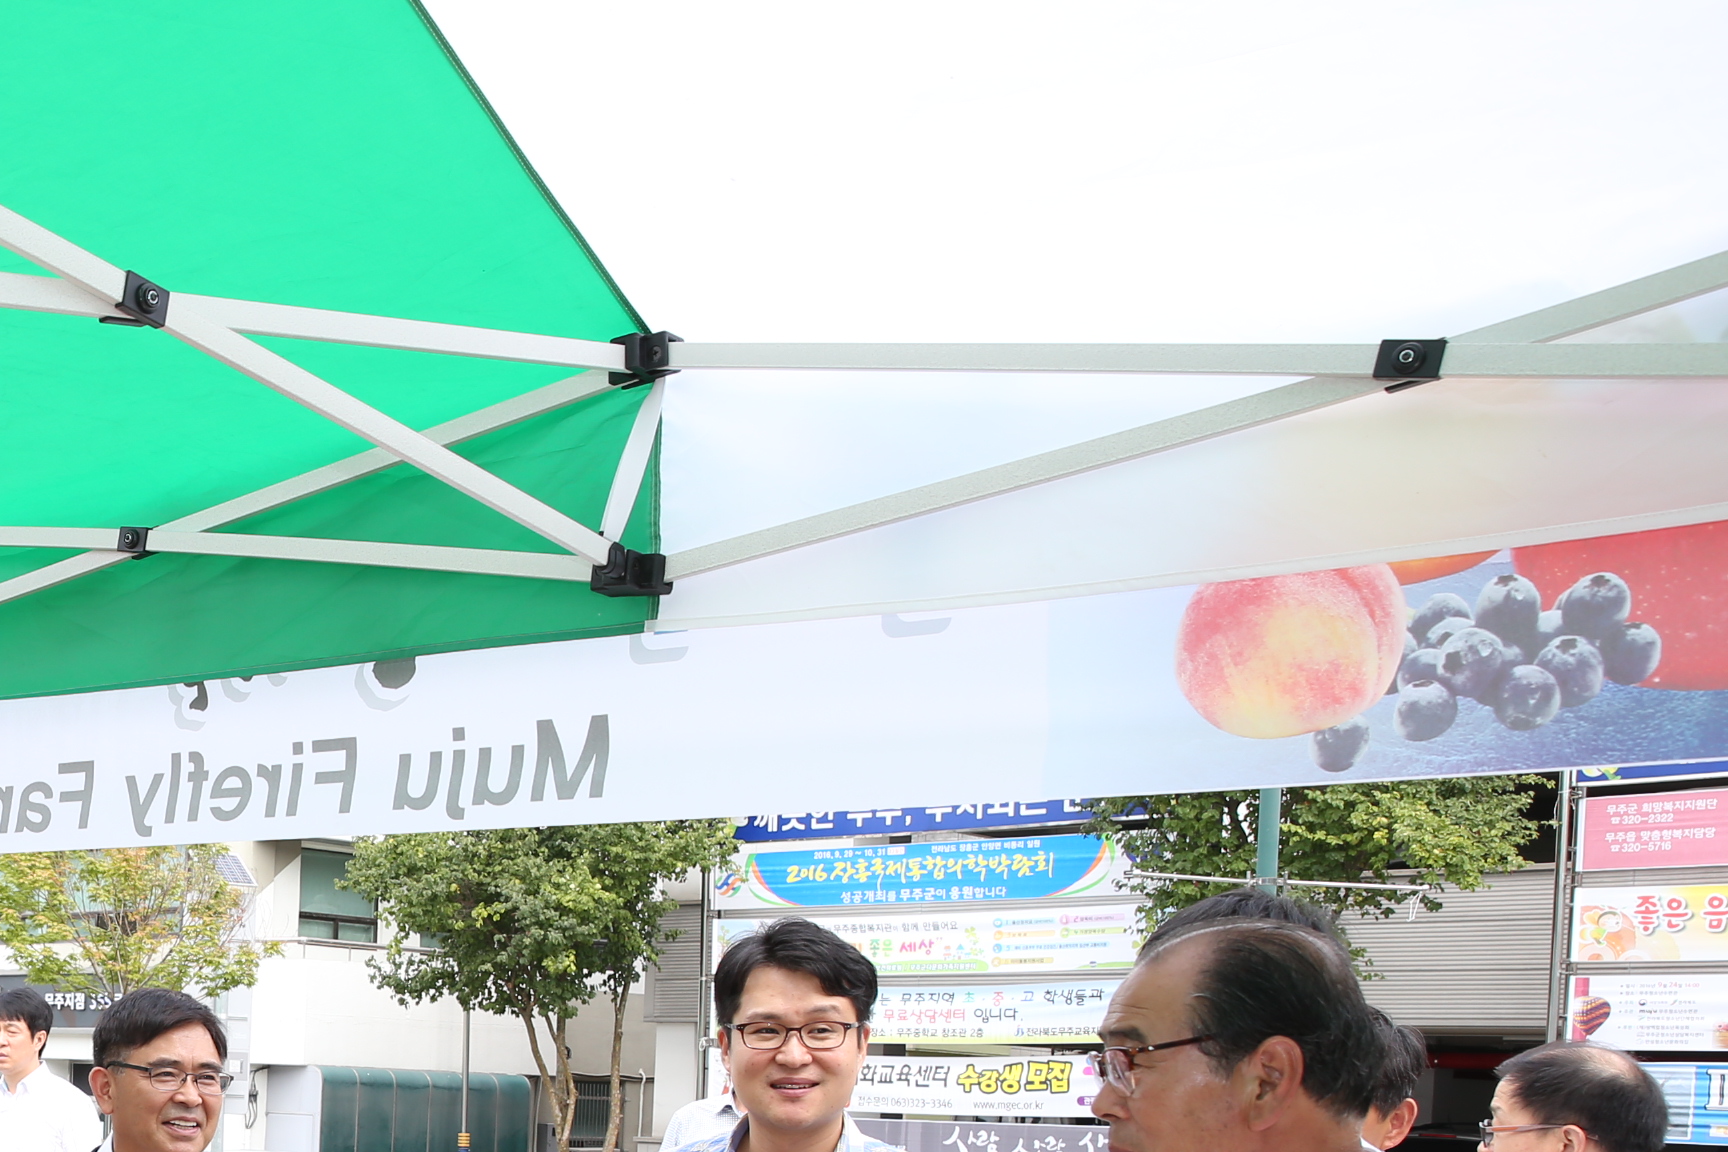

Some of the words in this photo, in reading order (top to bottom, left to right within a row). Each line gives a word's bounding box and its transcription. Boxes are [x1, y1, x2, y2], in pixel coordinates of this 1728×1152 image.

[1607, 804, 1638, 815] 무주군
[1642, 799, 1717, 812] 희망복지지원단
[1622, 814, 1673, 824] 320-2322
[1605, 832, 1636, 842] 무주읍
[1640, 827, 1716, 841] 맞춤형복지담당
[1622, 842, 1671, 852] 320-5716
[787, 864, 827, 882] 2016
[841, 890, 896, 903] 성공개최를
[900, 887, 946, 902] 무주군이
[949, 887, 1006, 899] 응원합니다
[1633, 896, 1689, 932] 좋은
[1703, 896, 1728, 929] 음
[902, 923, 919, 932] 함께
[923, 921, 958, 931] 만들어요
[870, 939, 893, 957] 좋은
[900, 992, 955, 1004] 무주지역
[1044, 989, 1104, 1005] 학생들과
[884, 1009, 966, 1023] 무료상담센터
[897, 1027, 937, 1037] 무주중학교
[942, 1027, 967, 1037] 창조관
[970, 1028, 984, 1037] 2층
[957, 1063, 1024, 1094] 수강생
[1025, 1061, 1073, 1093] 모집
[891, 1097, 952, 1109] 063)323-3346
[973, 1100, 1044, 1111] www.mgec.or.kr
